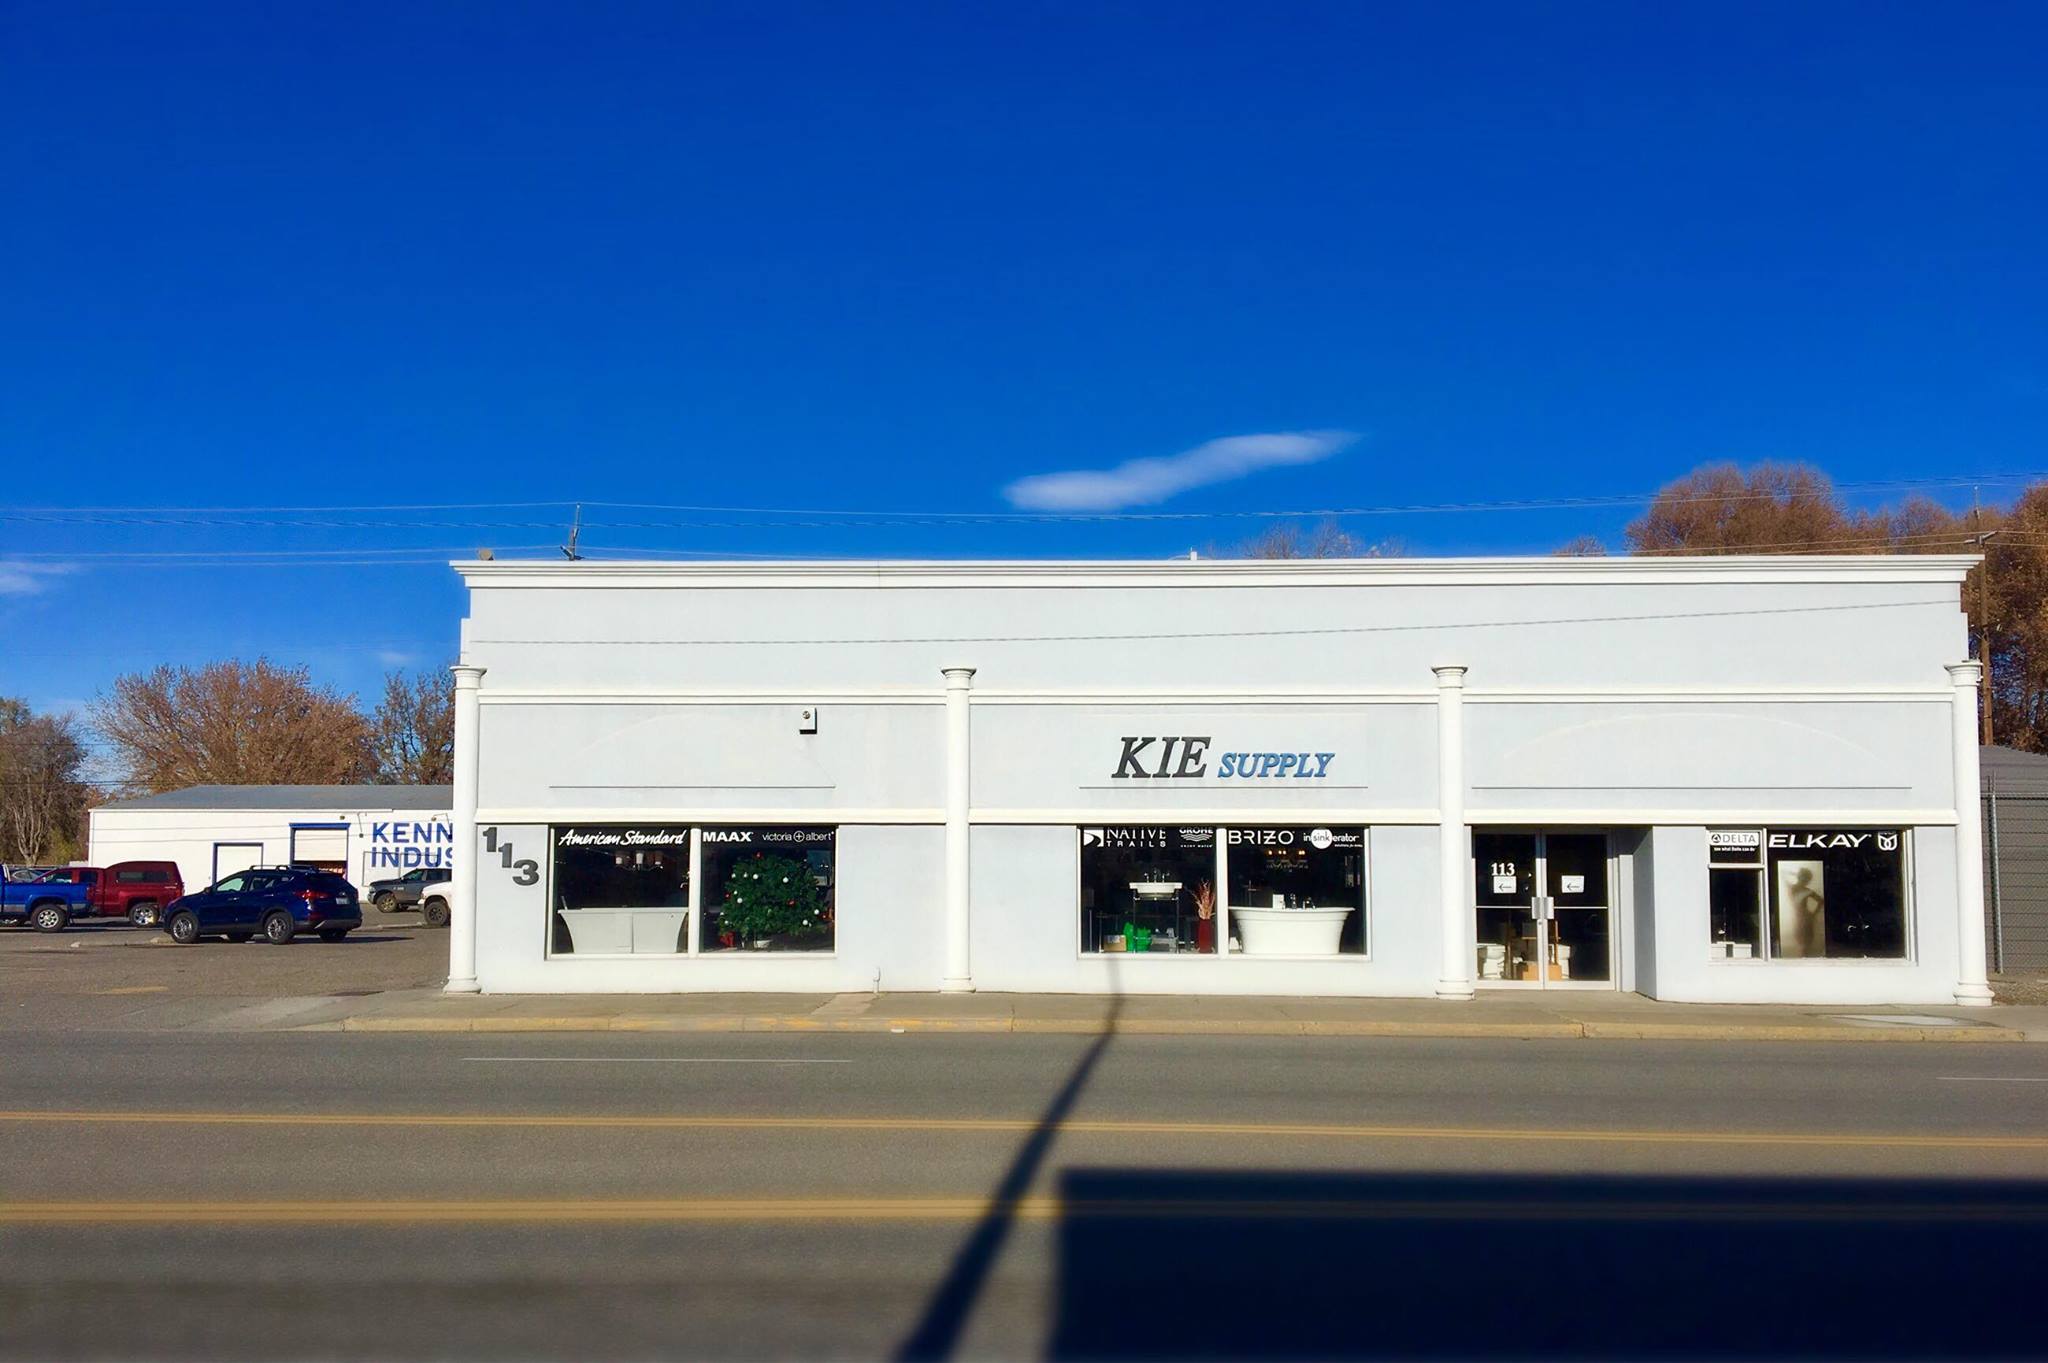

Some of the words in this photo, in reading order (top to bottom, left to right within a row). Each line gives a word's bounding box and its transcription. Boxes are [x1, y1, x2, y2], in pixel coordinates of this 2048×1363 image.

[1111, 736, 1211, 778] KIE
[1217, 752, 1335, 778] SUPPLY
[372, 822, 453, 843] KENN
[558, 829, 621, 846] American
[620, 829, 687, 846] Standard
[702, 831, 752, 842] MAAX
[762, 832, 792, 841] victoria
[805, 832, 832, 841] albert
[1106, 828, 1167, 840] NATIVE
[1228, 830, 1294, 845] BRIZO
[1722, 834, 1756, 843] DELTA
[1106, 840, 1167, 848] TRAILS
[1768, 833, 1868, 848] ELKAY
[1491, 862, 1515, 876] 113
